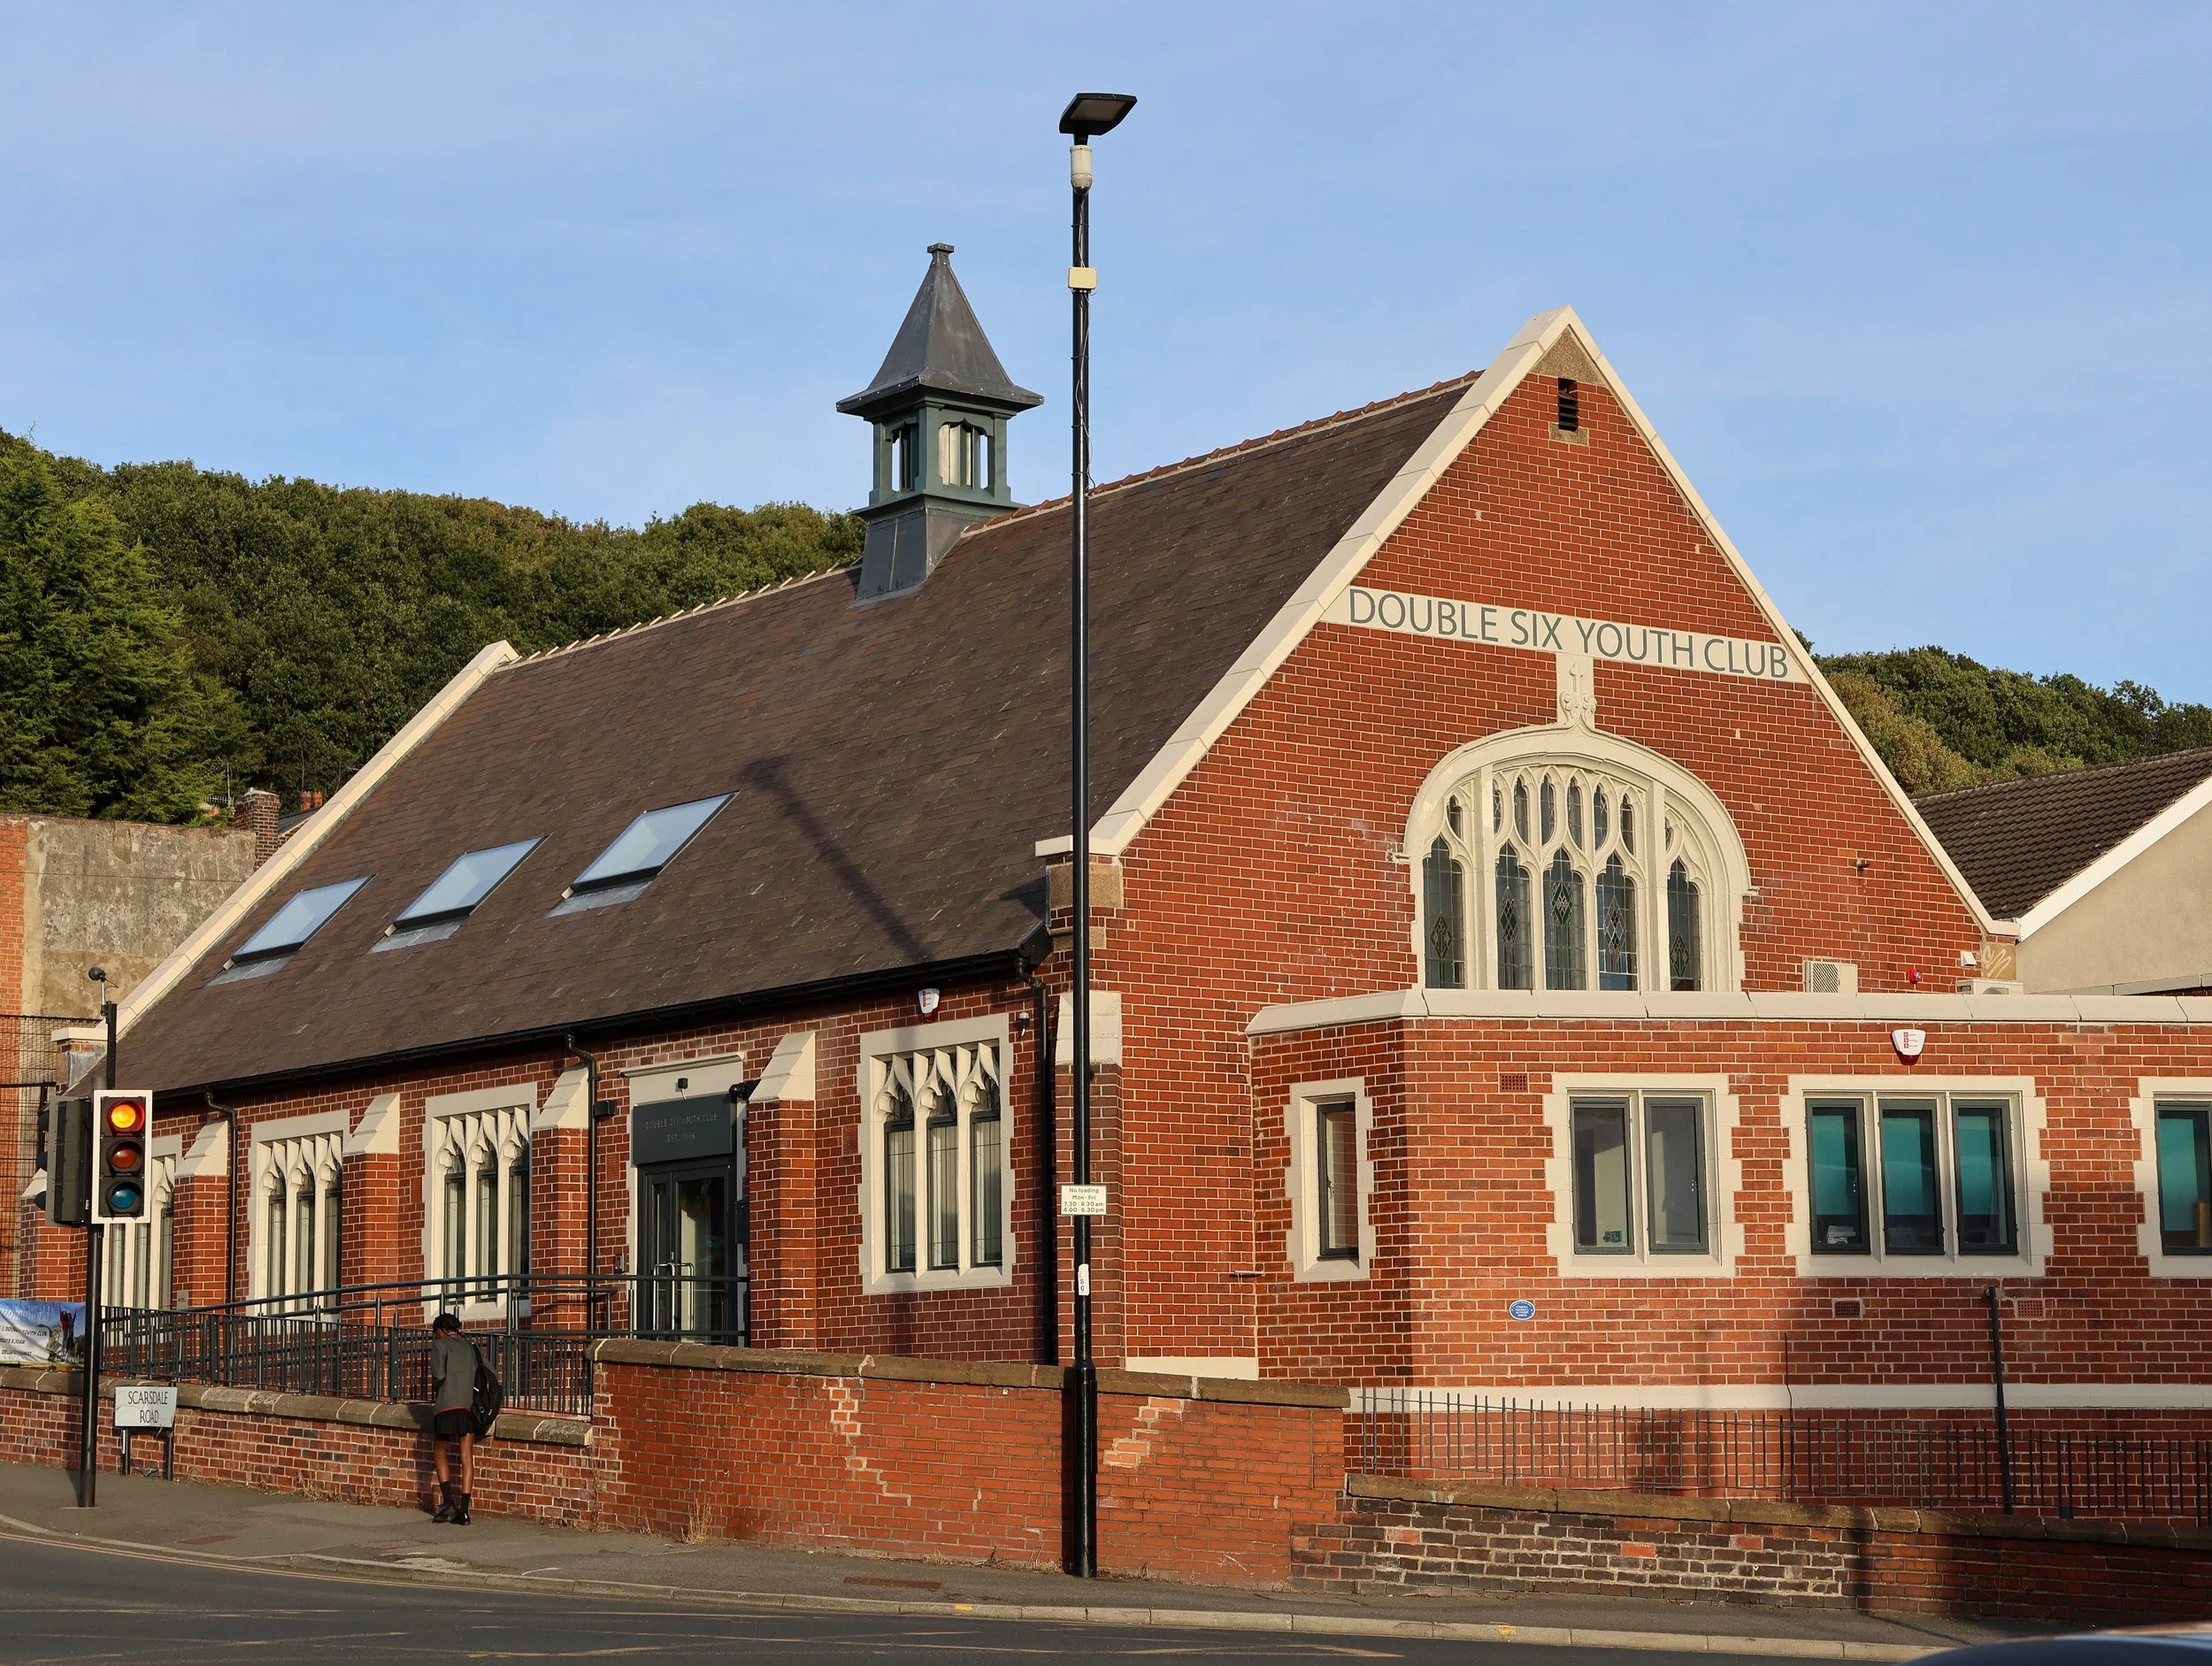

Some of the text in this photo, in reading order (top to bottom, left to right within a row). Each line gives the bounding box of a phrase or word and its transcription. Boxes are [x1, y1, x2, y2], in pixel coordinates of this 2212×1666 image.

[1349, 588, 1788, 679] DOUBLE SIX YOUTH CLUB
[127, 1390, 168, 1405] SCARSDALE
[139, 1409, 159, 1424] ROAD
